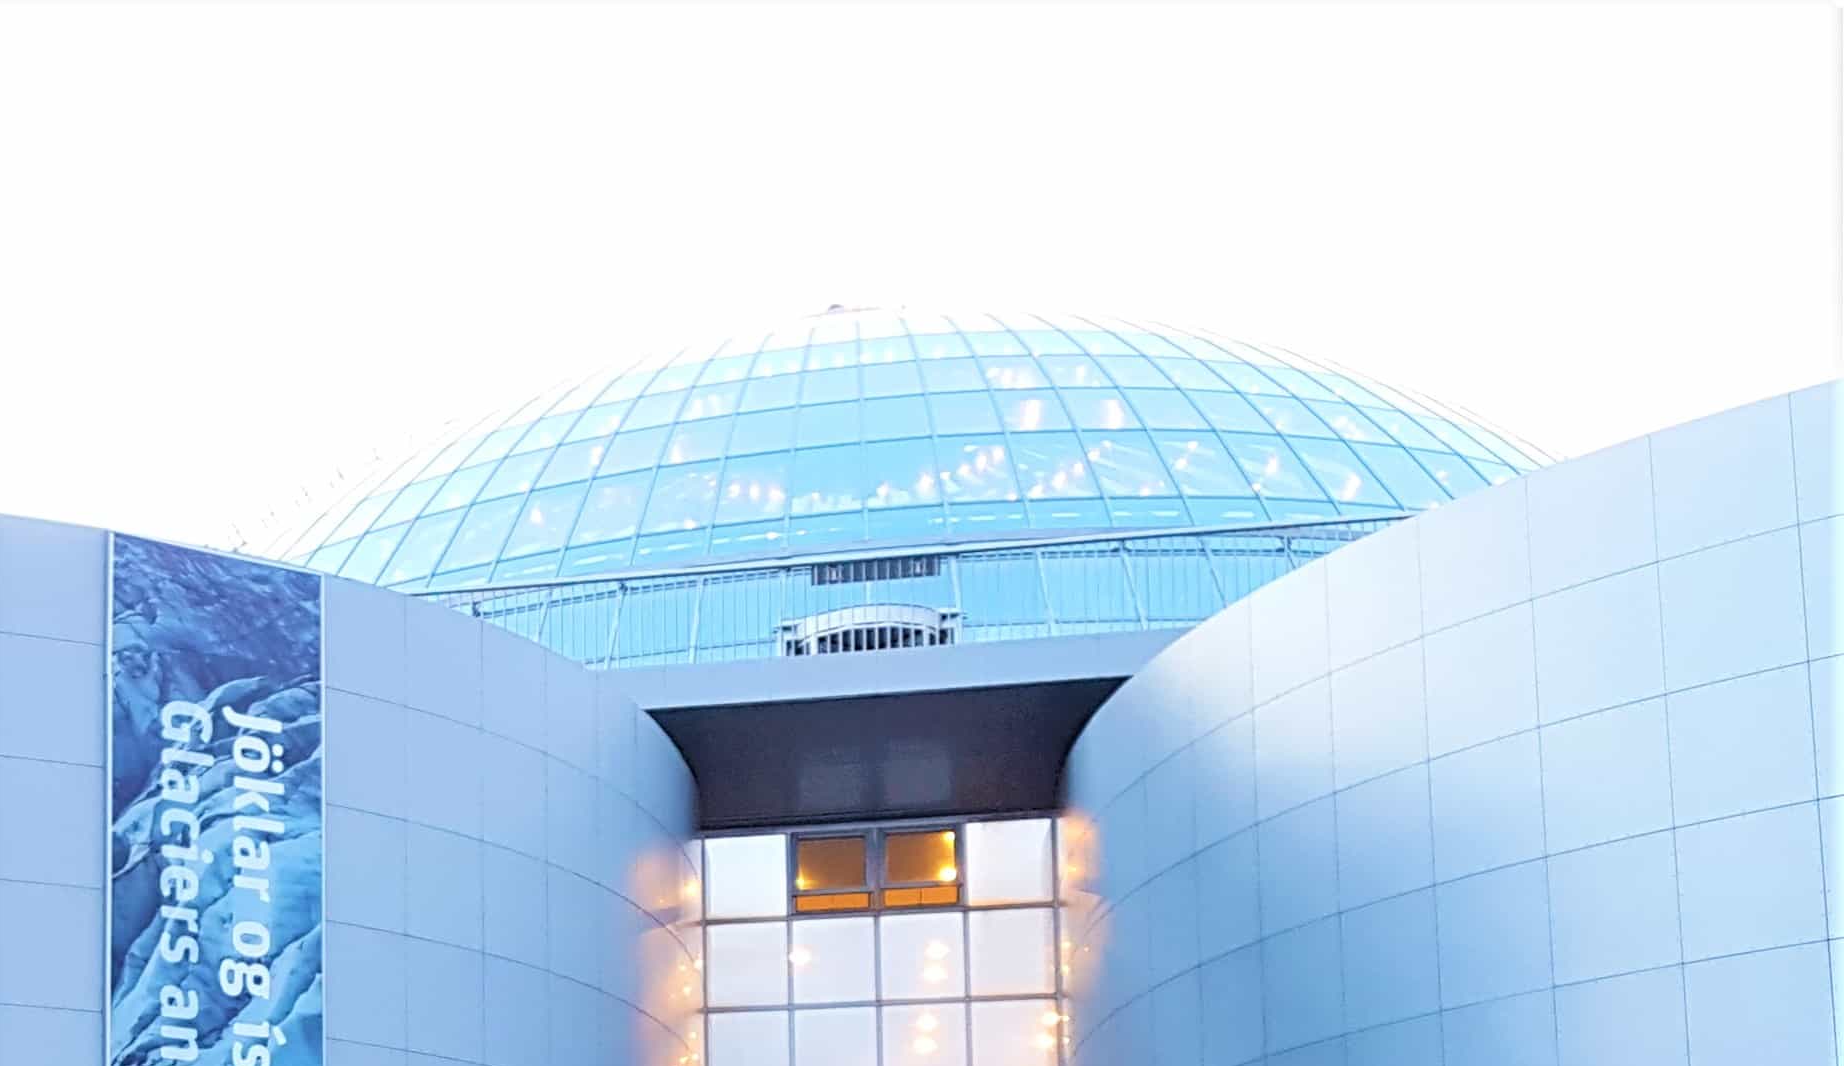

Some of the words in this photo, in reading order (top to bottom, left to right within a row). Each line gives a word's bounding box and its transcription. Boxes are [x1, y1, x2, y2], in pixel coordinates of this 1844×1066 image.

[160, 700, 214, 964] Glaciers
[222, 705, 284, 903] Jöklar
[219, 920, 271, 1000] og
